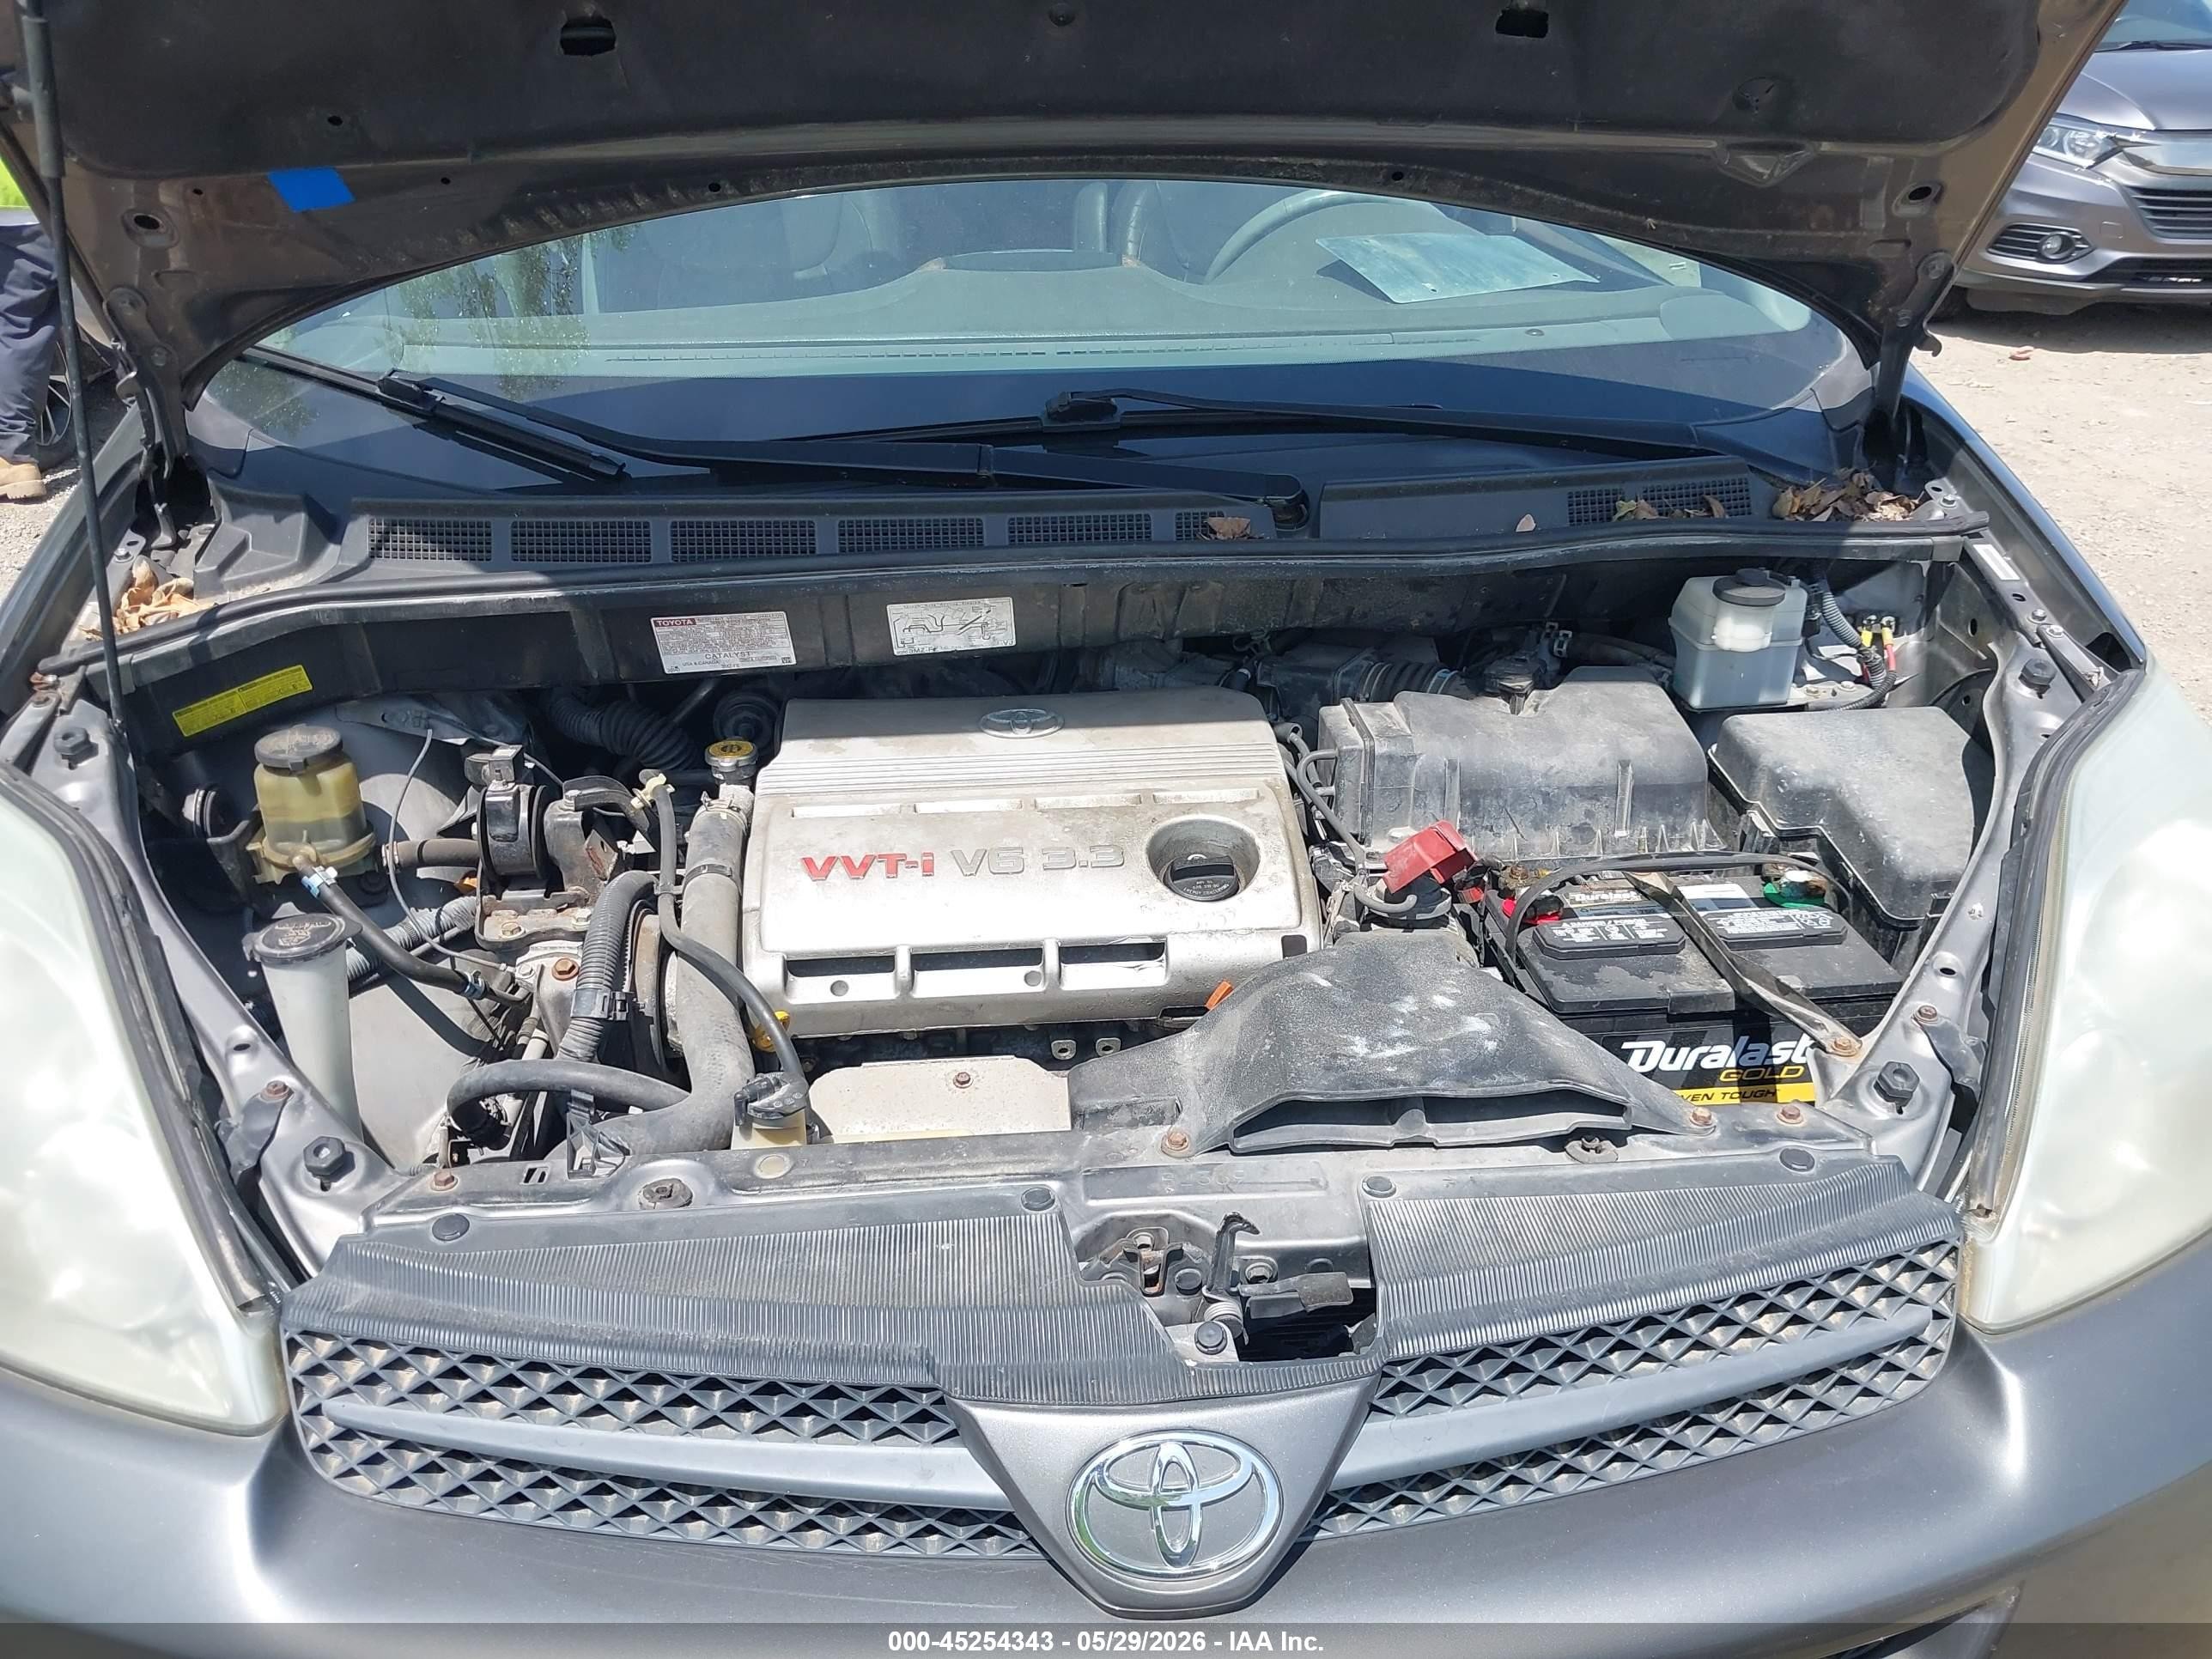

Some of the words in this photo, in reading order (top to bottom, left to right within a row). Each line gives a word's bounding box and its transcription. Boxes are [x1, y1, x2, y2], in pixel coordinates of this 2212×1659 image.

[802, 852, 935, 881] VVT-i
[950, 847, 1025, 877] V6
[1042, 844, 1125, 871] 3.3
[1621, 1034, 1816, 1073] Duralast
[1719, 1066, 1804, 1083] GOLD
[1721, 1089, 1777, 1100] TOUGH
